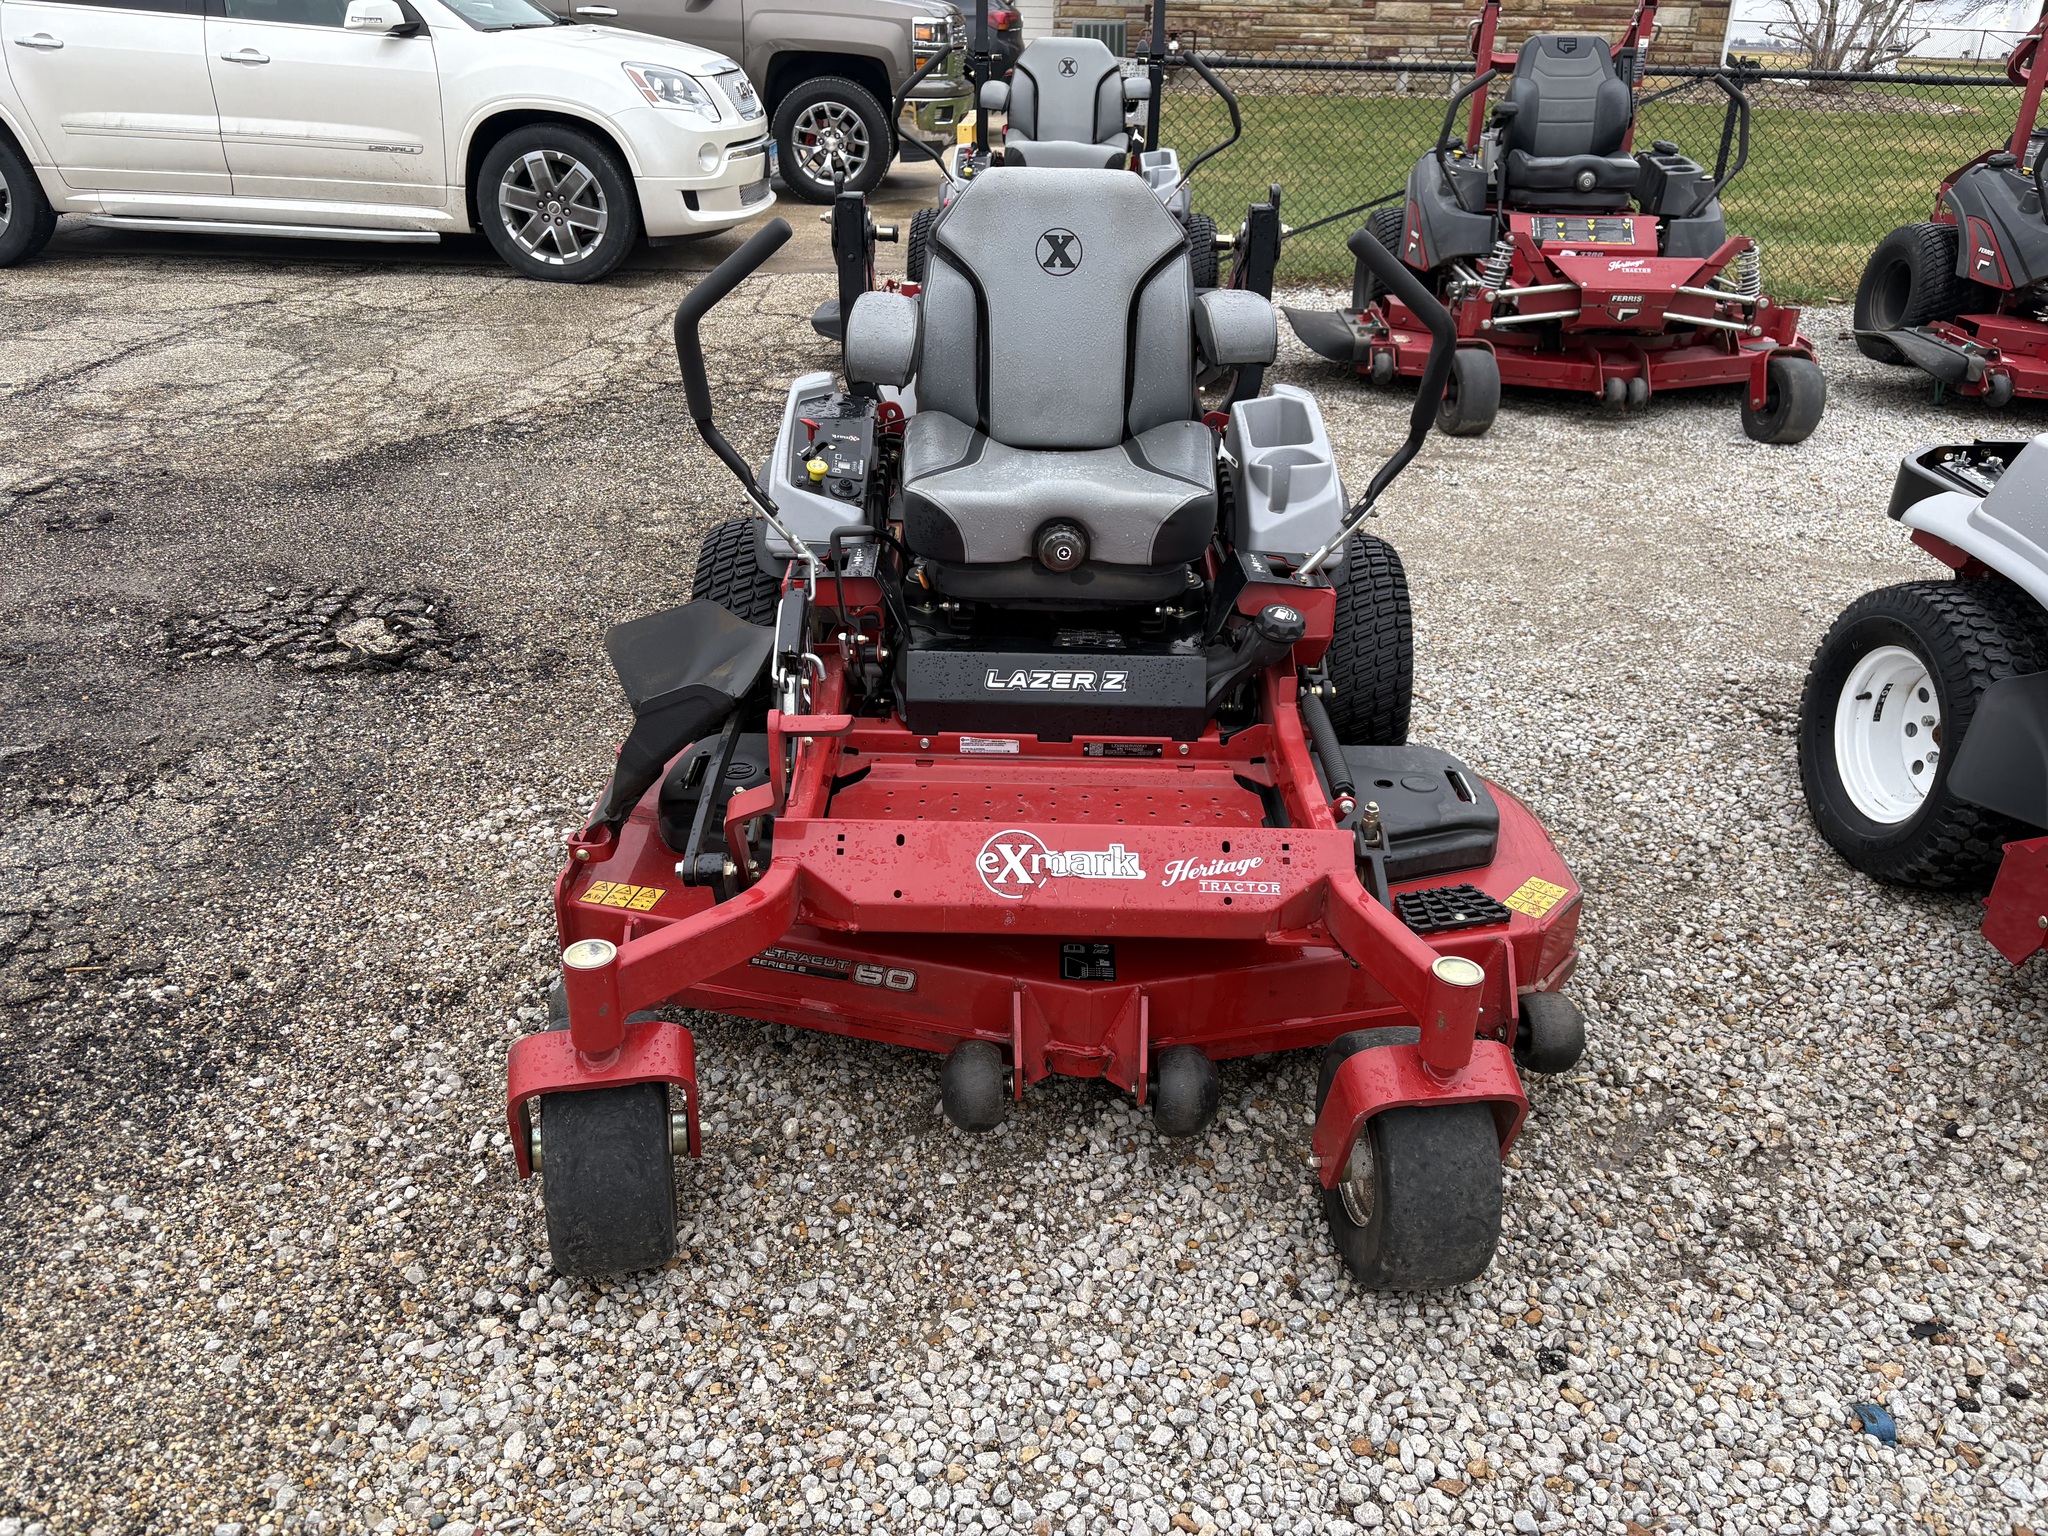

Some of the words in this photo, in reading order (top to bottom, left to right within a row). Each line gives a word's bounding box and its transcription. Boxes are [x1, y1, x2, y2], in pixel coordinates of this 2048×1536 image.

[1060, 59, 1076, 75] X
[1040, 232, 1078, 270] X
[1608, 260, 1645, 271] Heritage
[985, 670, 1096, 690] LAZER
[1101, 671, 1128, 690] Z
[977, 842, 1145, 886] eXmark
[1162, 856, 1264, 887] Heritage
[1200, 882, 1281, 893] TRACTOR
[751, 957, 796, 971] SERIES
[764, 946, 850, 970] LTRACUT
[854, 962, 917, 992] 60
